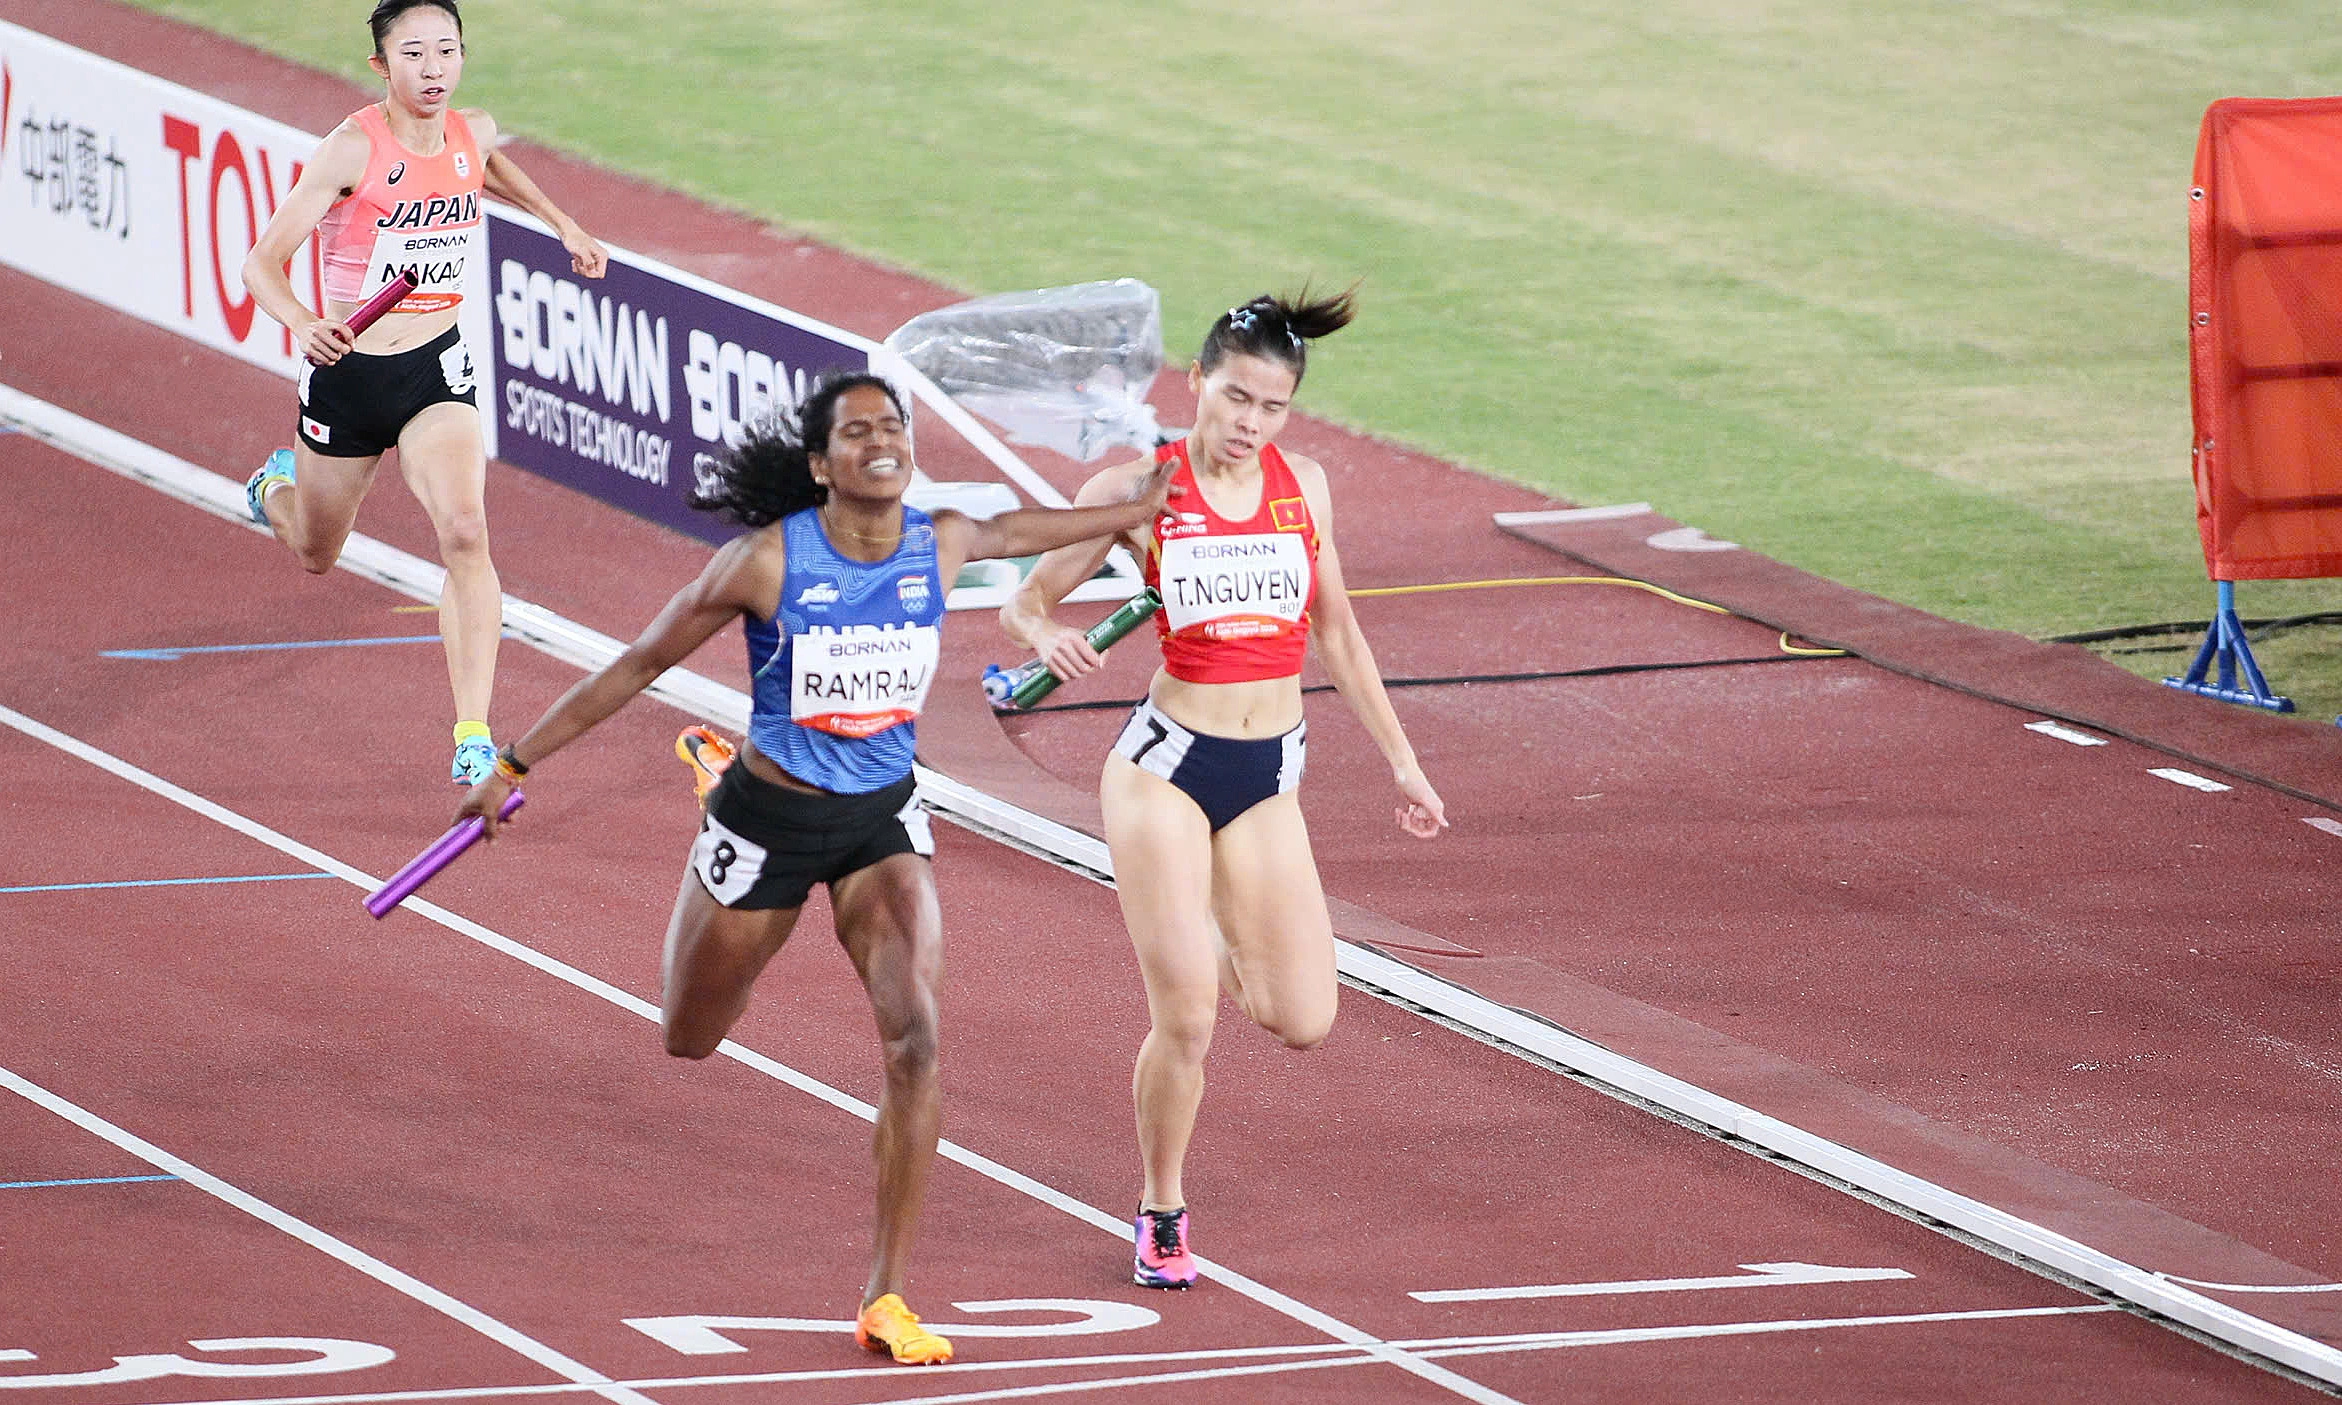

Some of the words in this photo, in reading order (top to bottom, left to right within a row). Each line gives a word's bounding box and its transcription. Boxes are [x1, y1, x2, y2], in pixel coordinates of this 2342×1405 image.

[18, 102, 130, 240] 中部電力
[376, 190, 478, 229] JAPAN
[404, 234, 468, 250] BORNAN
[496, 258, 672, 424] BORNAN
[505, 378, 568, 448] SPORTS
[565, 400, 673, 488] TECHNOLOGY
[1191, 541, 1277, 559] BORNAN
[1172, 567, 1300, 607] T.NGUYEN
[829, 639, 912, 657] BORNAN
[803, 663, 927, 701] RAMRAJ
[1131, 715, 1169, 766] 7
[710, 840, 737, 885] 8
